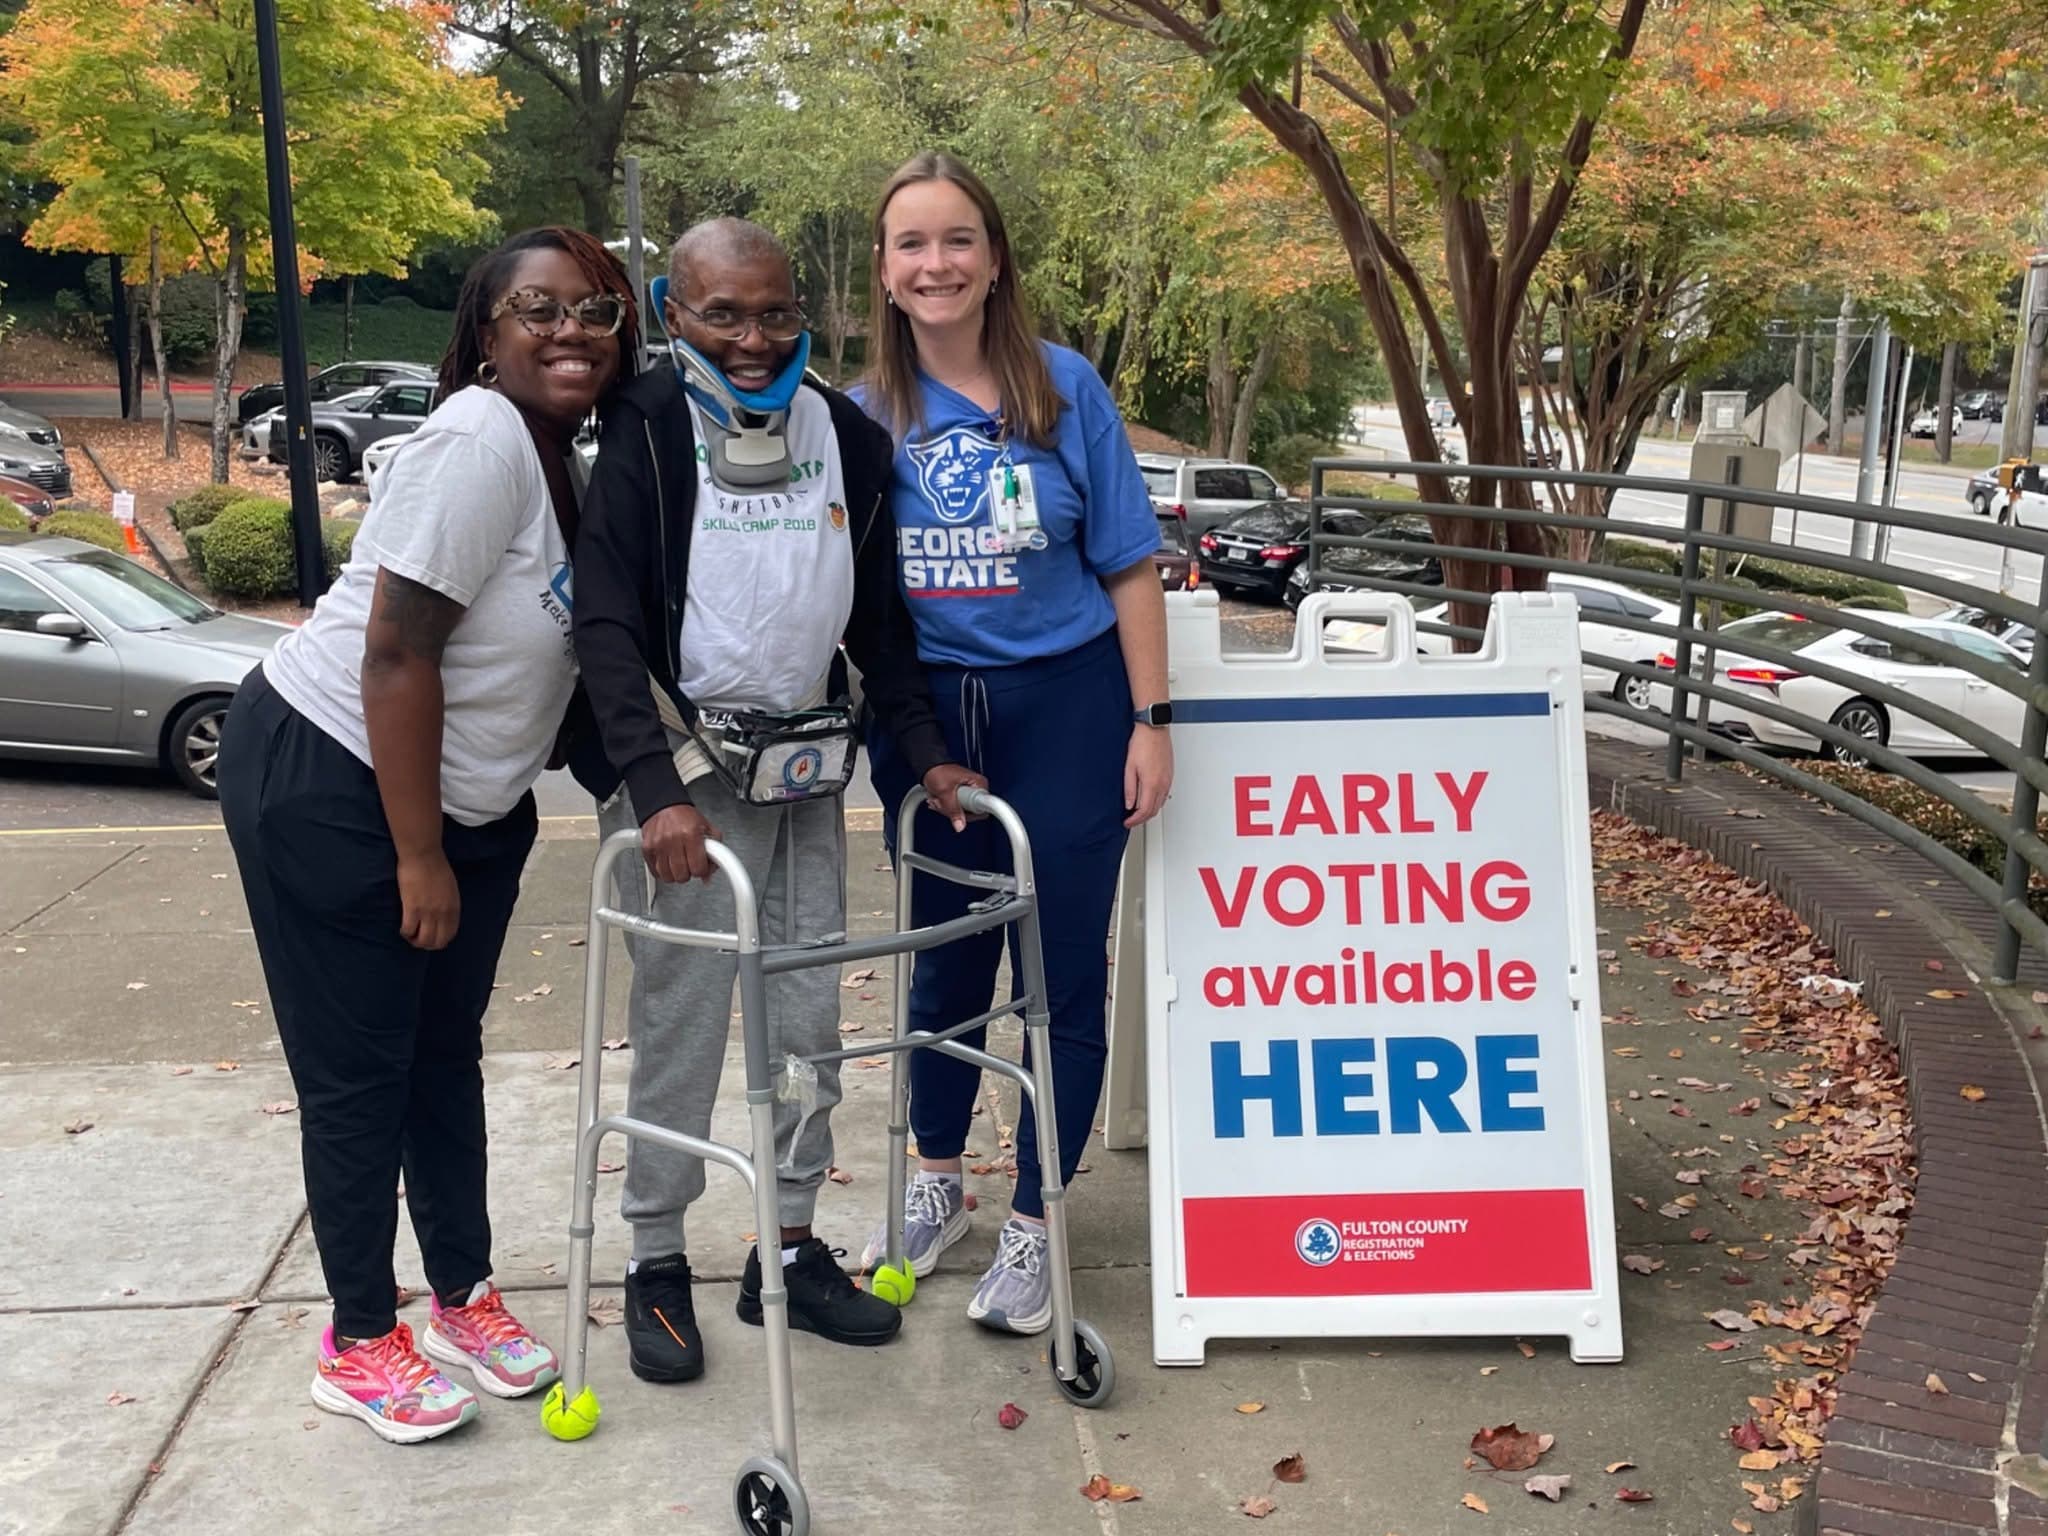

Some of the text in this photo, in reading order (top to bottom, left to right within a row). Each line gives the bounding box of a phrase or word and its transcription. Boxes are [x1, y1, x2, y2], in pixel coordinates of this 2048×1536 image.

[742, 519, 779, 532] CAMP
[783, 518, 816, 531] 2018
[903, 557, 1019, 588] STATE
[1233, 771, 1489, 837] EARLY
[1199, 860, 1532, 929] VOTING
[1203, 947, 1538, 1008] available
[1210, 1034, 1546, 1139] HERE
[1341, 1219, 1469, 1236] FULTON COUNTY
[1343, 1238, 1425, 1250] REGISTRATION
[1343, 1250, 1416, 1262] & ELECTIONS
